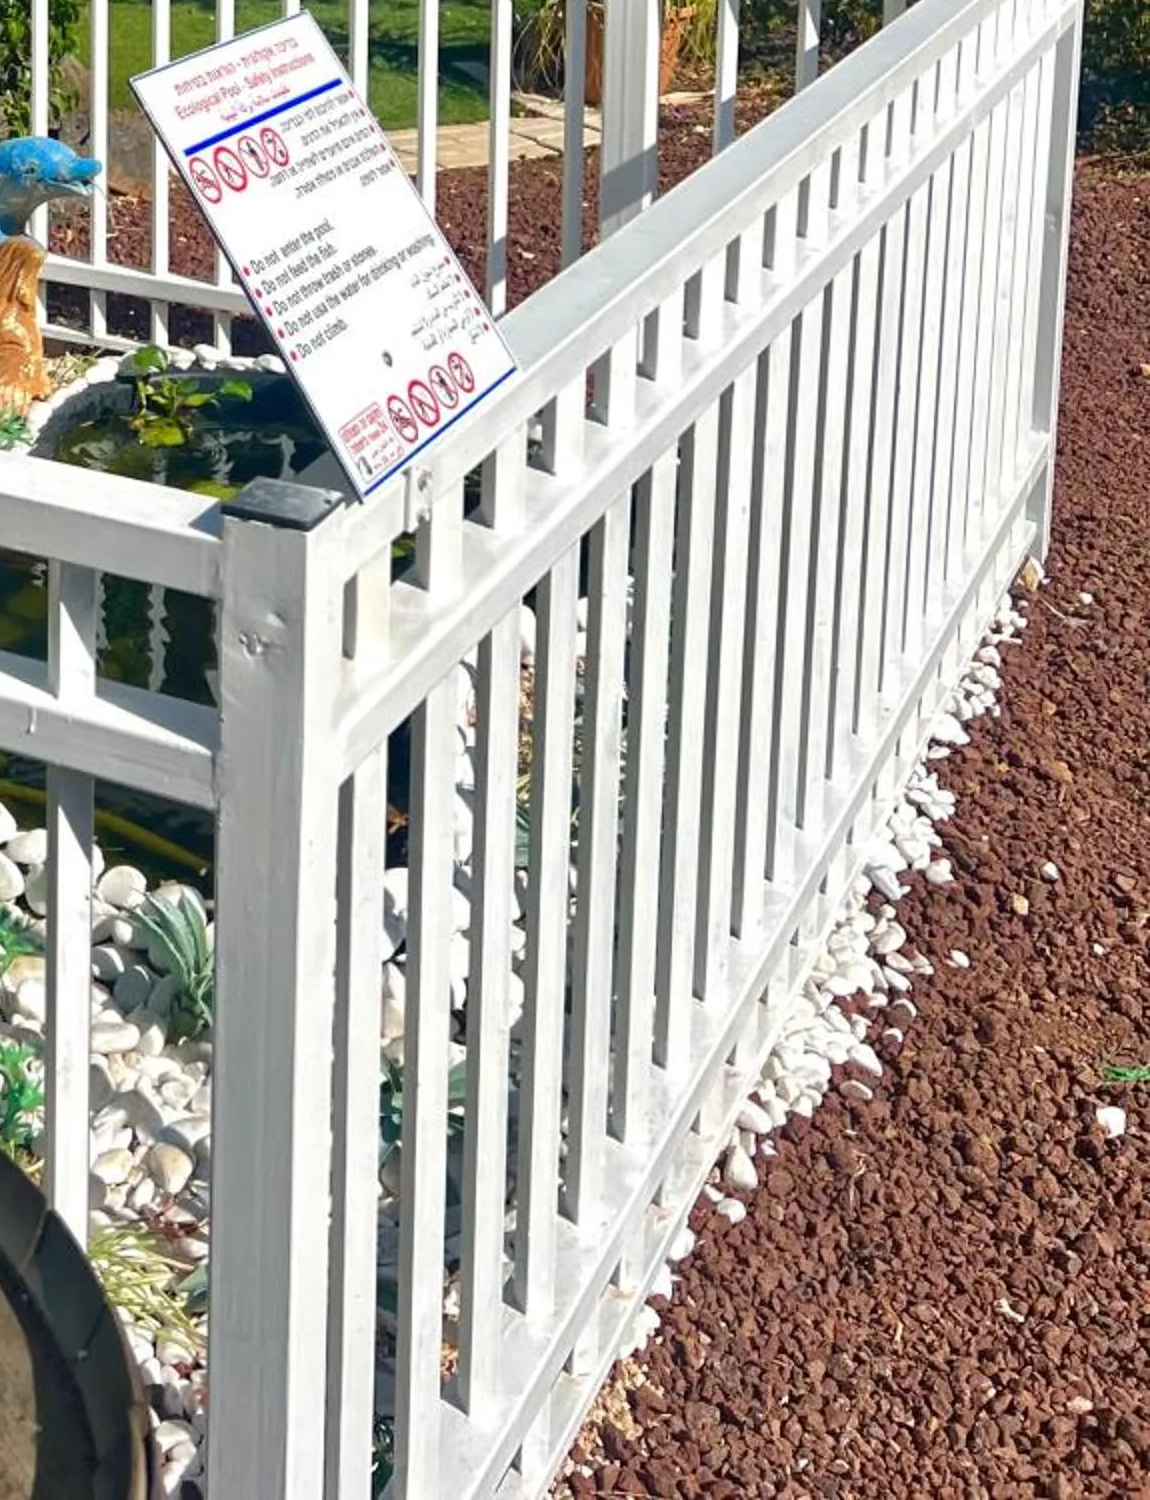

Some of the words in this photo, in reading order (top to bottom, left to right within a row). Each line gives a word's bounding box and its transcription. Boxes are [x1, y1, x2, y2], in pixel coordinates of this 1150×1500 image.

[175, 92, 221, 119] Ecological
[220, 83, 241, 98] Pool
[250, 260, 266, 275] Do
[264, 250, 280, 266] not
[280, 238, 302, 257] enter
[300, 231, 315, 245] the
[261, 280, 277, 295] Do
[276, 270, 291, 288] not
[288, 259, 308, 278] feed
[306, 253, 322, 268] the
[272, 300, 288, 316] Do
[287, 291, 303, 306] not
[300, 279, 324, 298] throw
[322, 264, 344, 284] trash
[342, 260, 352, 272] or
[284, 321, 299, 336] Do
[298, 310, 314, 328] not
[312, 303, 328, 319] use
[326, 294, 341, 308] the
[339, 281, 360, 300] water
[358, 273, 371, 286] for
[370, 256, 401, 280] drinking
[398, 250, 406, 262] or
[296, 344, 312, 358] Do
[310, 332, 326, 349] not
